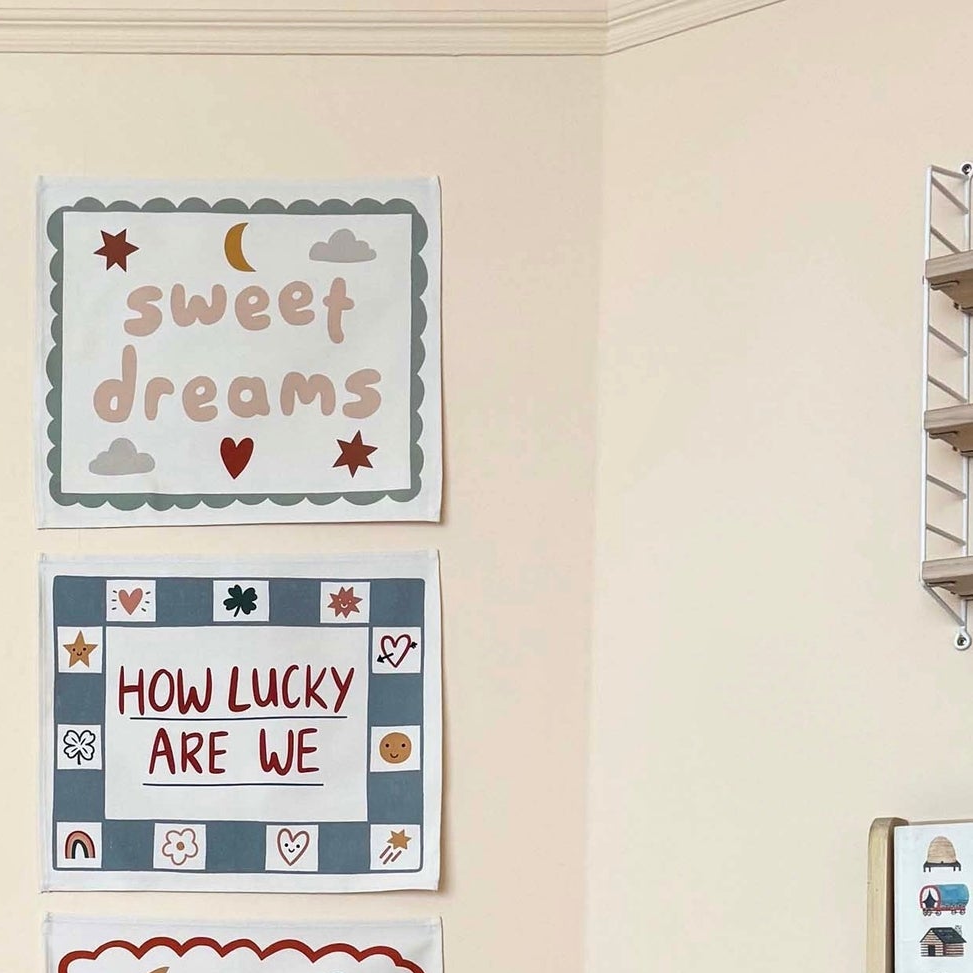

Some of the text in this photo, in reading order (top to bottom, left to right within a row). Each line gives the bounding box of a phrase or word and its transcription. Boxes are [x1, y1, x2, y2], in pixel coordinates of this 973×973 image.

[123, 277, 355, 344] sweet
[93, 344, 382, 423] dreams
[118, 664, 355, 716] HOW LUCKY
[148, 727, 320, 776] ARE WE
